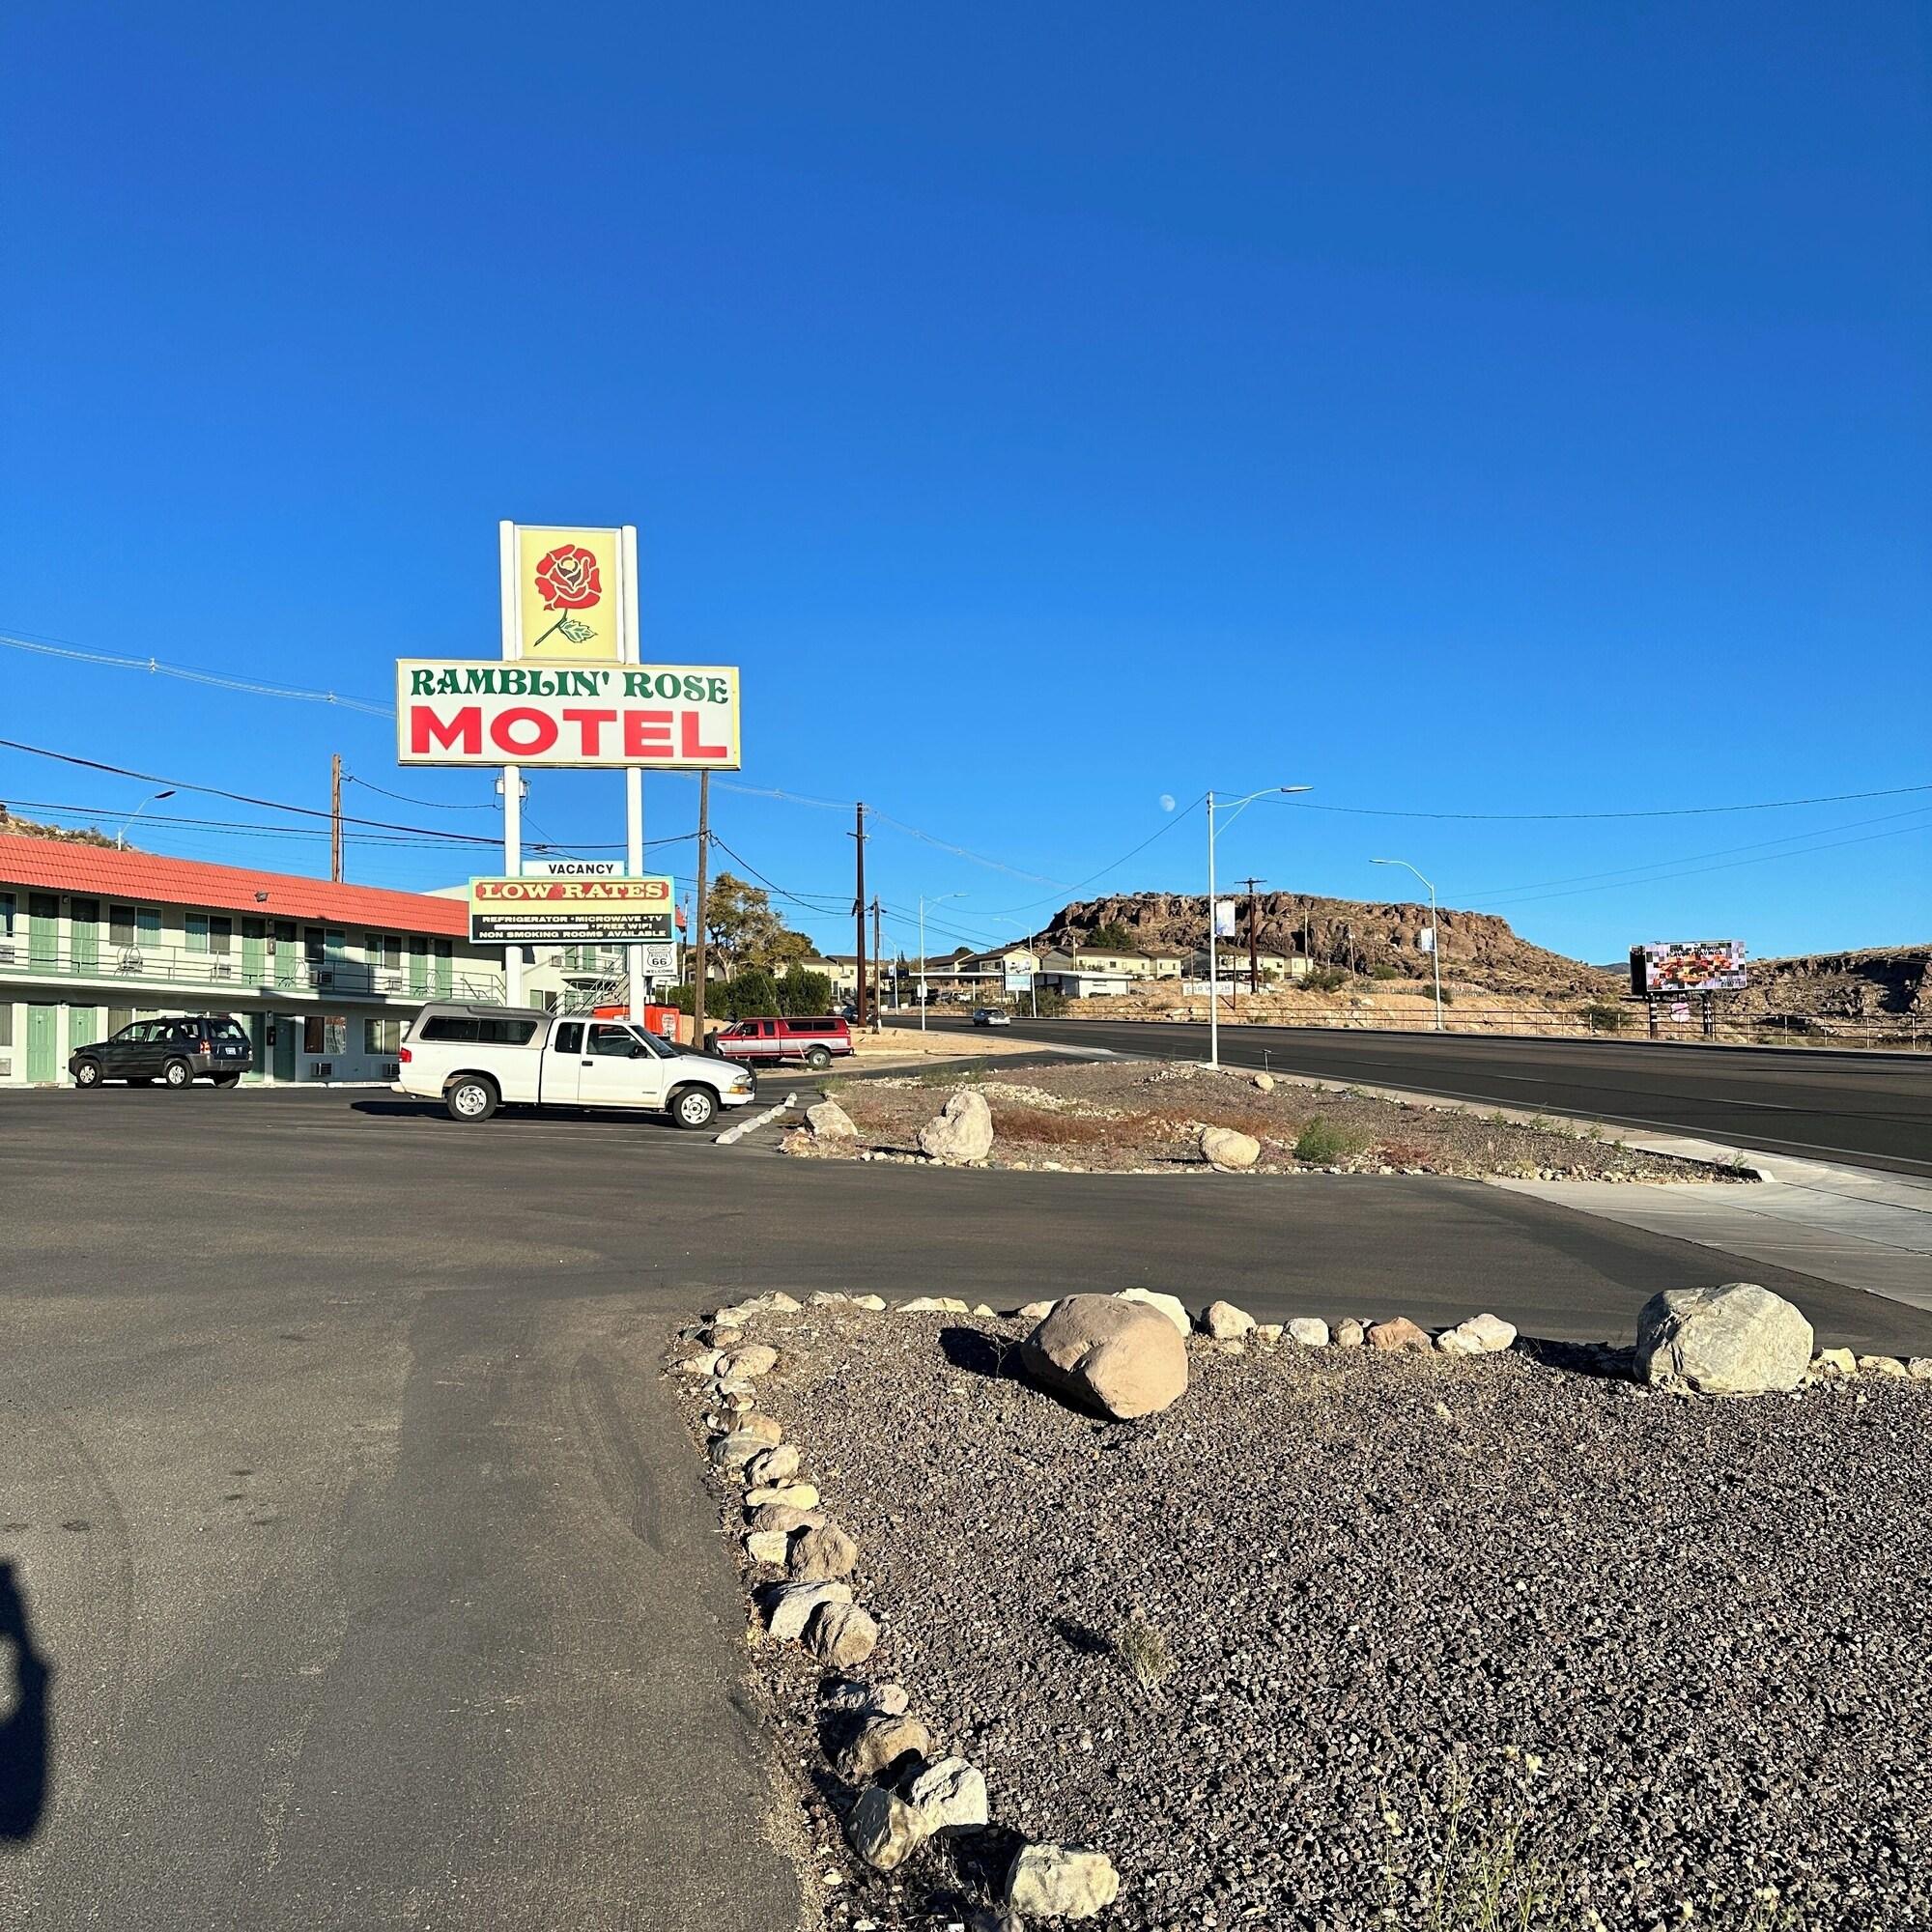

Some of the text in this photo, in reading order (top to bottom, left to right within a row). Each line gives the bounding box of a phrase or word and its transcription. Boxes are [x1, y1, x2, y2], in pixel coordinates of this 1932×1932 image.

[411, 668, 728, 704] RAMBLIN' ROSE
[411, 705, 727, 758] MOTEL
[549, 864, 614, 874] VACANCY
[482, 883, 664, 898] LOW RATES
